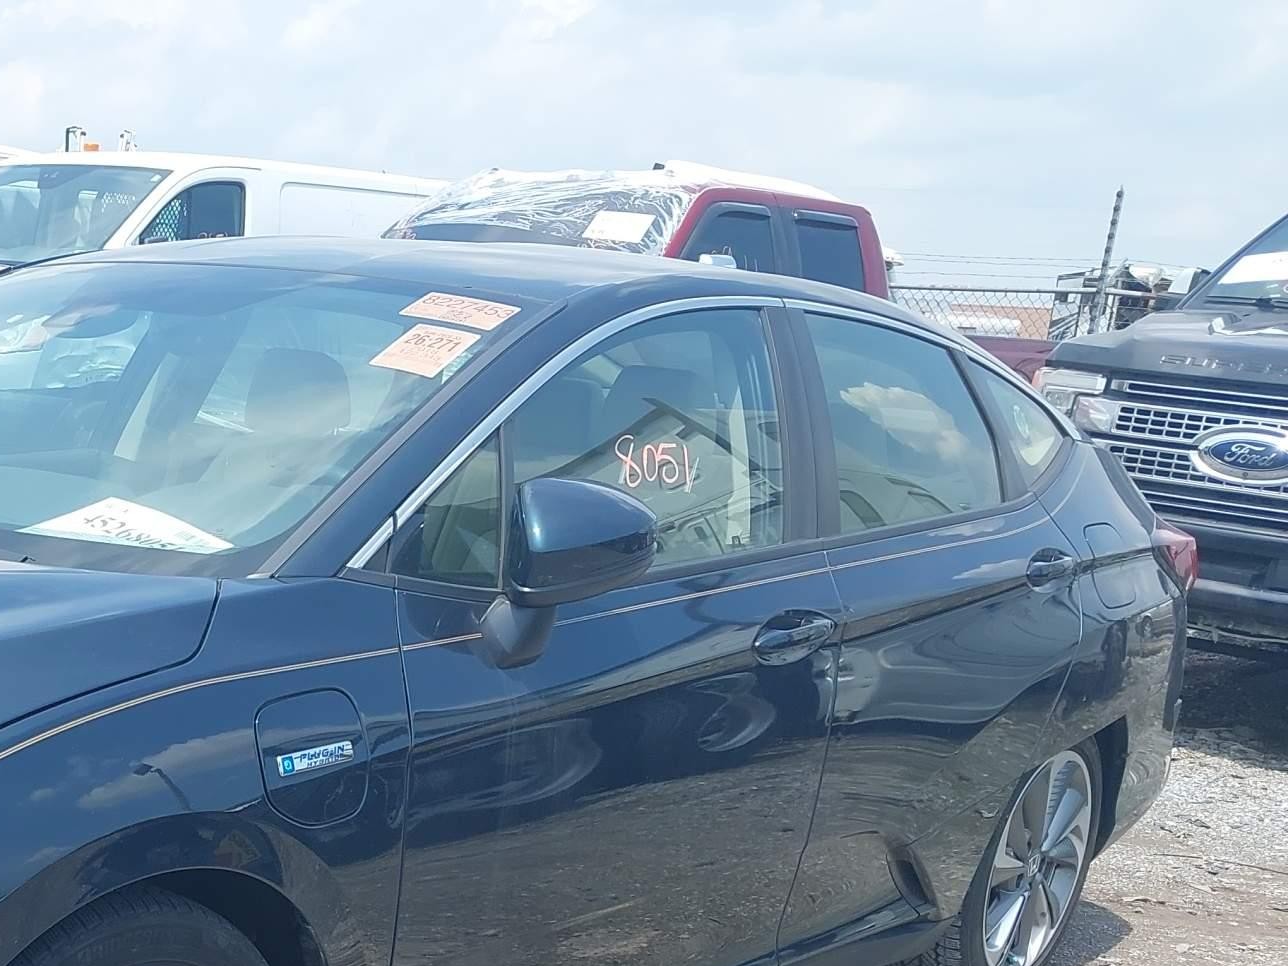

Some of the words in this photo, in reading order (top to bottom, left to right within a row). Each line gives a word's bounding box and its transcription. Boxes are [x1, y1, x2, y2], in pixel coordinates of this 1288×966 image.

[422, 295, 515, 320] 8227453
[615, 434, 691, 492] 8051
[1224, 443, 1277, 467] Ford
